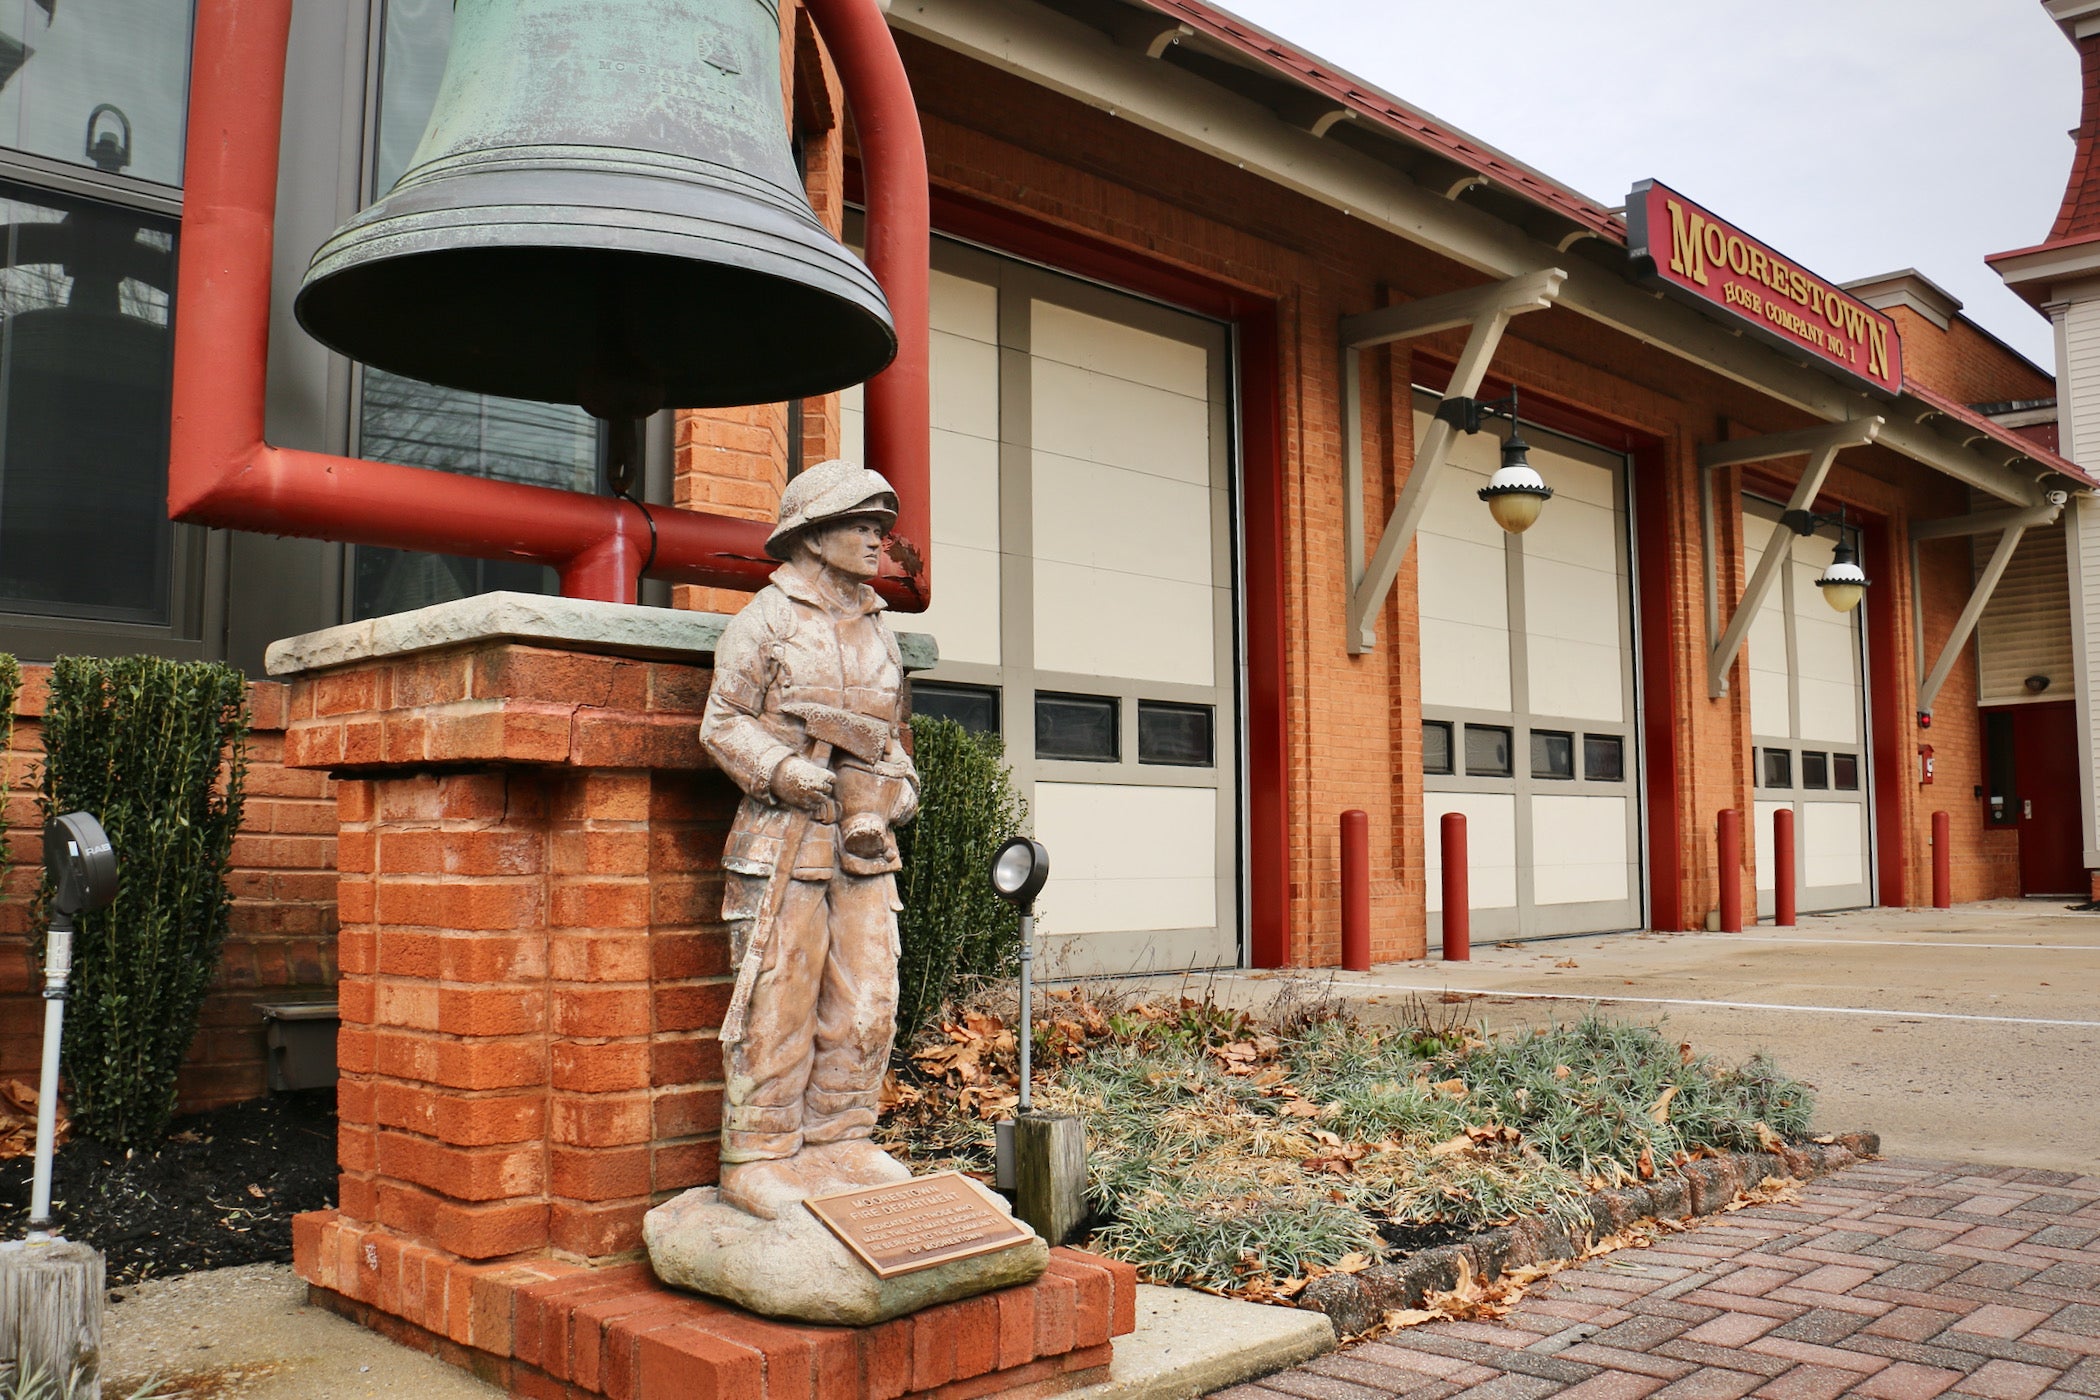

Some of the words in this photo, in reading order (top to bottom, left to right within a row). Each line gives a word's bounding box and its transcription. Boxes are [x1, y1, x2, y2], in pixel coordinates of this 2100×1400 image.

[1667, 198, 1889, 381] MOORESTOWN
[1722, 280, 1762, 314] HOSE
[1765, 300, 1824, 348] COMPANY
[1827, 333, 1847, 359] NO.
[1849, 346, 1857, 364] 1
[849, 1208, 881, 1221] FIRE
[882, 1191, 961, 1215] DEPARTMENT
[851, 1185, 940, 1209] MOORESTOWN
[863, 1218, 911, 1233] DEDICATED
[911, 1214, 925, 1223] TO
[926, 1208, 954, 1219] THOSE
[955, 1204, 974, 1213] WHO
[887, 1229, 907, 1239] THE
[909, 1220, 947, 1234] ULTIMATE
[870, 1243, 883, 1252] IN
[884, 1236, 921, 1249] SERVICE
[922, 1232, 935, 1241] TO
[936, 1228, 952, 1237] THE
[953, 1218, 1001, 1233] COMMUNITY
[909, 1245, 922, 1254] OF
[923, 1231, 985, 1250] MOORESTOWN
